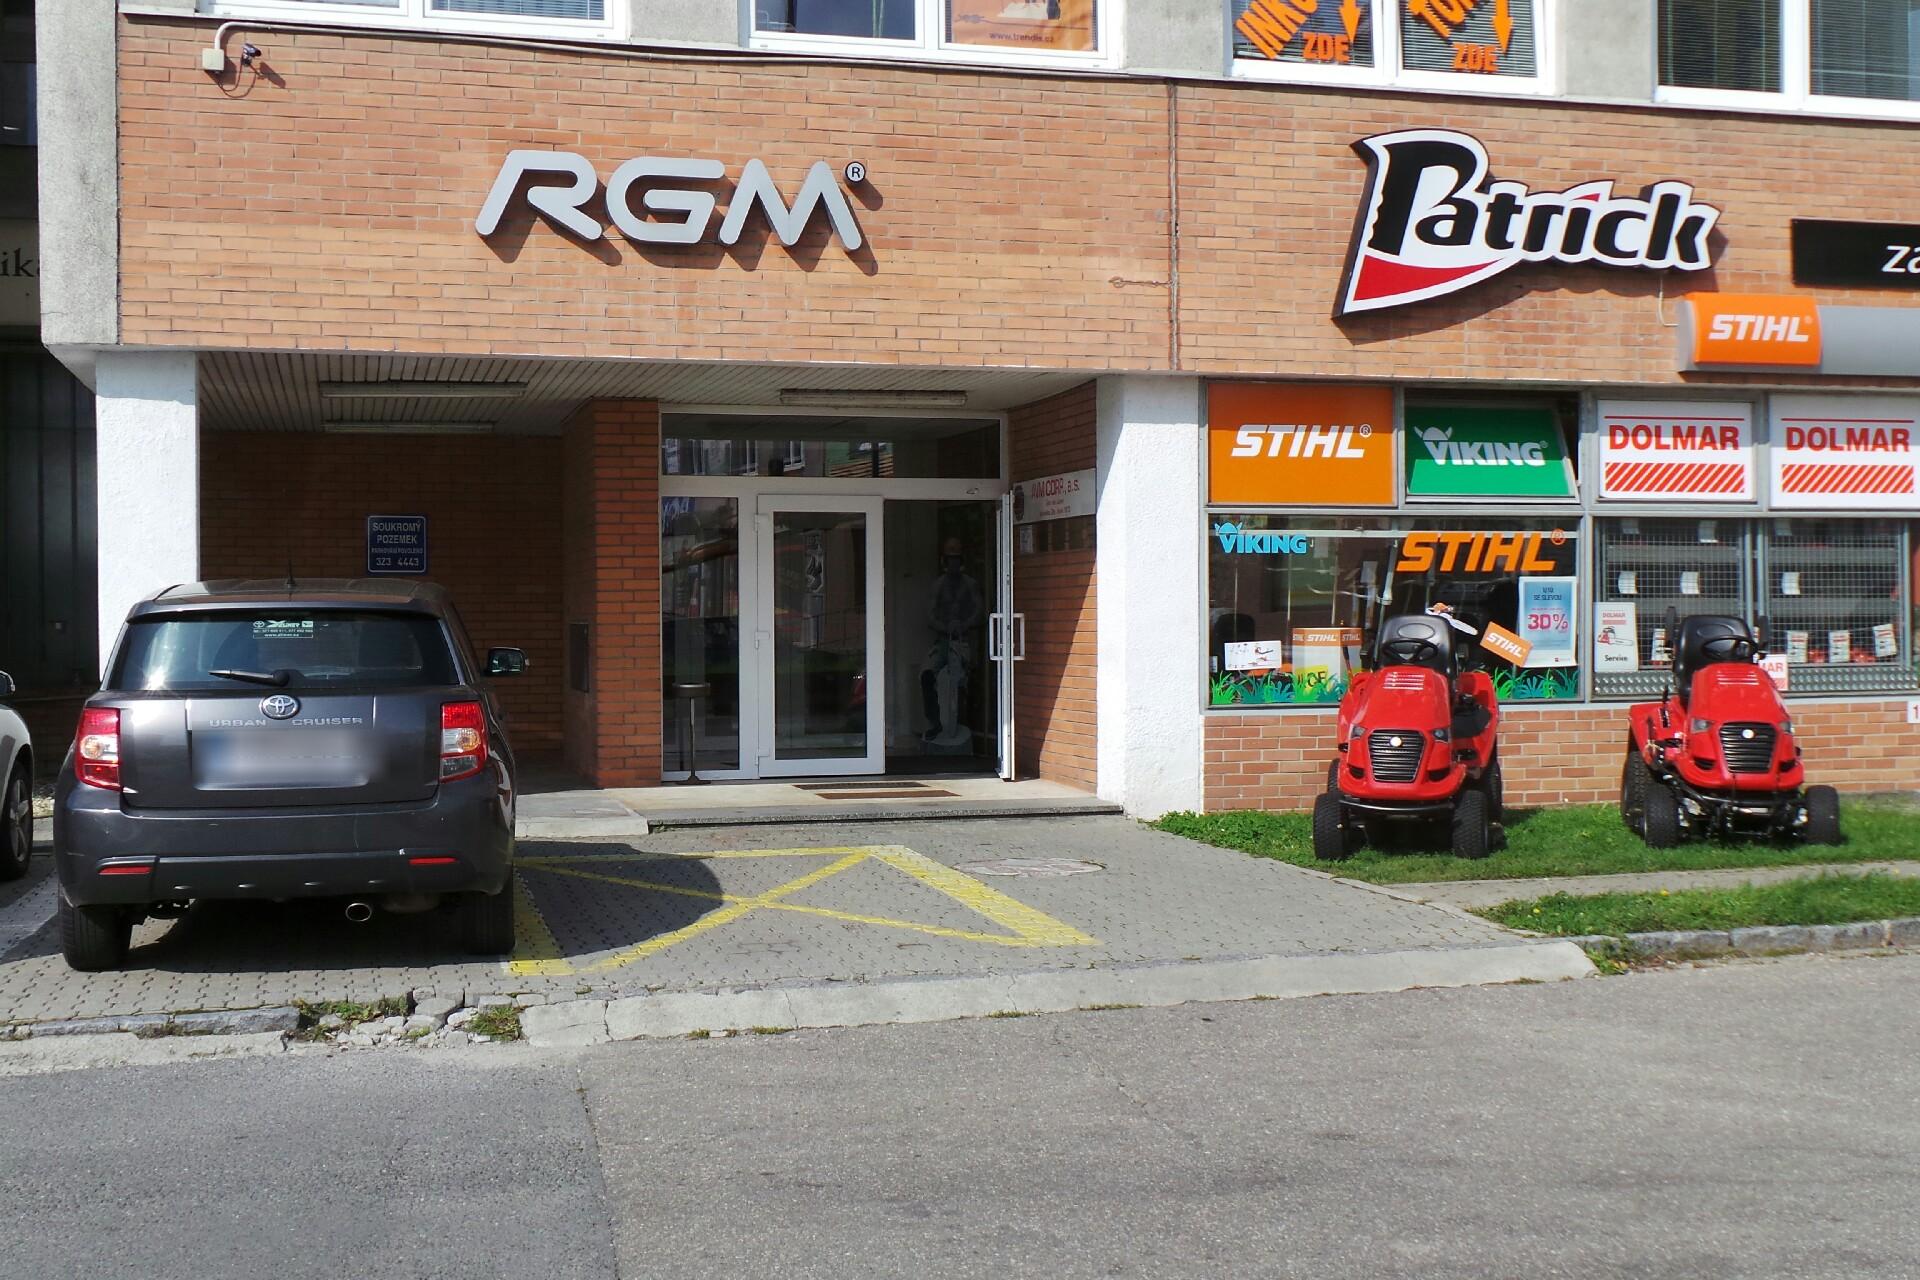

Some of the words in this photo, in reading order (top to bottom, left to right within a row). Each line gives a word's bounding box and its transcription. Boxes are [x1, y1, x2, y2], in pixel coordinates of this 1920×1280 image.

[1302, 31, 1351, 62] ZDE
[1451, 42, 1498, 72] ZDE
[475, 148, 863, 252] RGM
[1363, 134, 1712, 268] Patrick
[0, 247, 40, 278] ik
[1708, 314, 1810, 343] STIHL
[1231, 424, 1365, 459] STIHL
[1608, 424, 1740, 451] DOLMAR
[1785, 426, 1911, 453] DOLMAR
[1422, 438, 1547, 467] VIKING
[372, 520, 421, 531] SOUKROMÝ
[376, 534, 418, 544] POZEMEK
[1219, 532, 1308, 554] VIKING
[1396, 531, 1557, 573] STIHL
[1527, 613, 1569, 631] 30%
[1306, 633, 1337, 642] STIHL
[1486, 632, 1522, 658] STIHL
[1604, 654, 1628, 662] Service
[209, 719, 267, 728] URBAN
[292, 717, 363, 726] CRUISER
